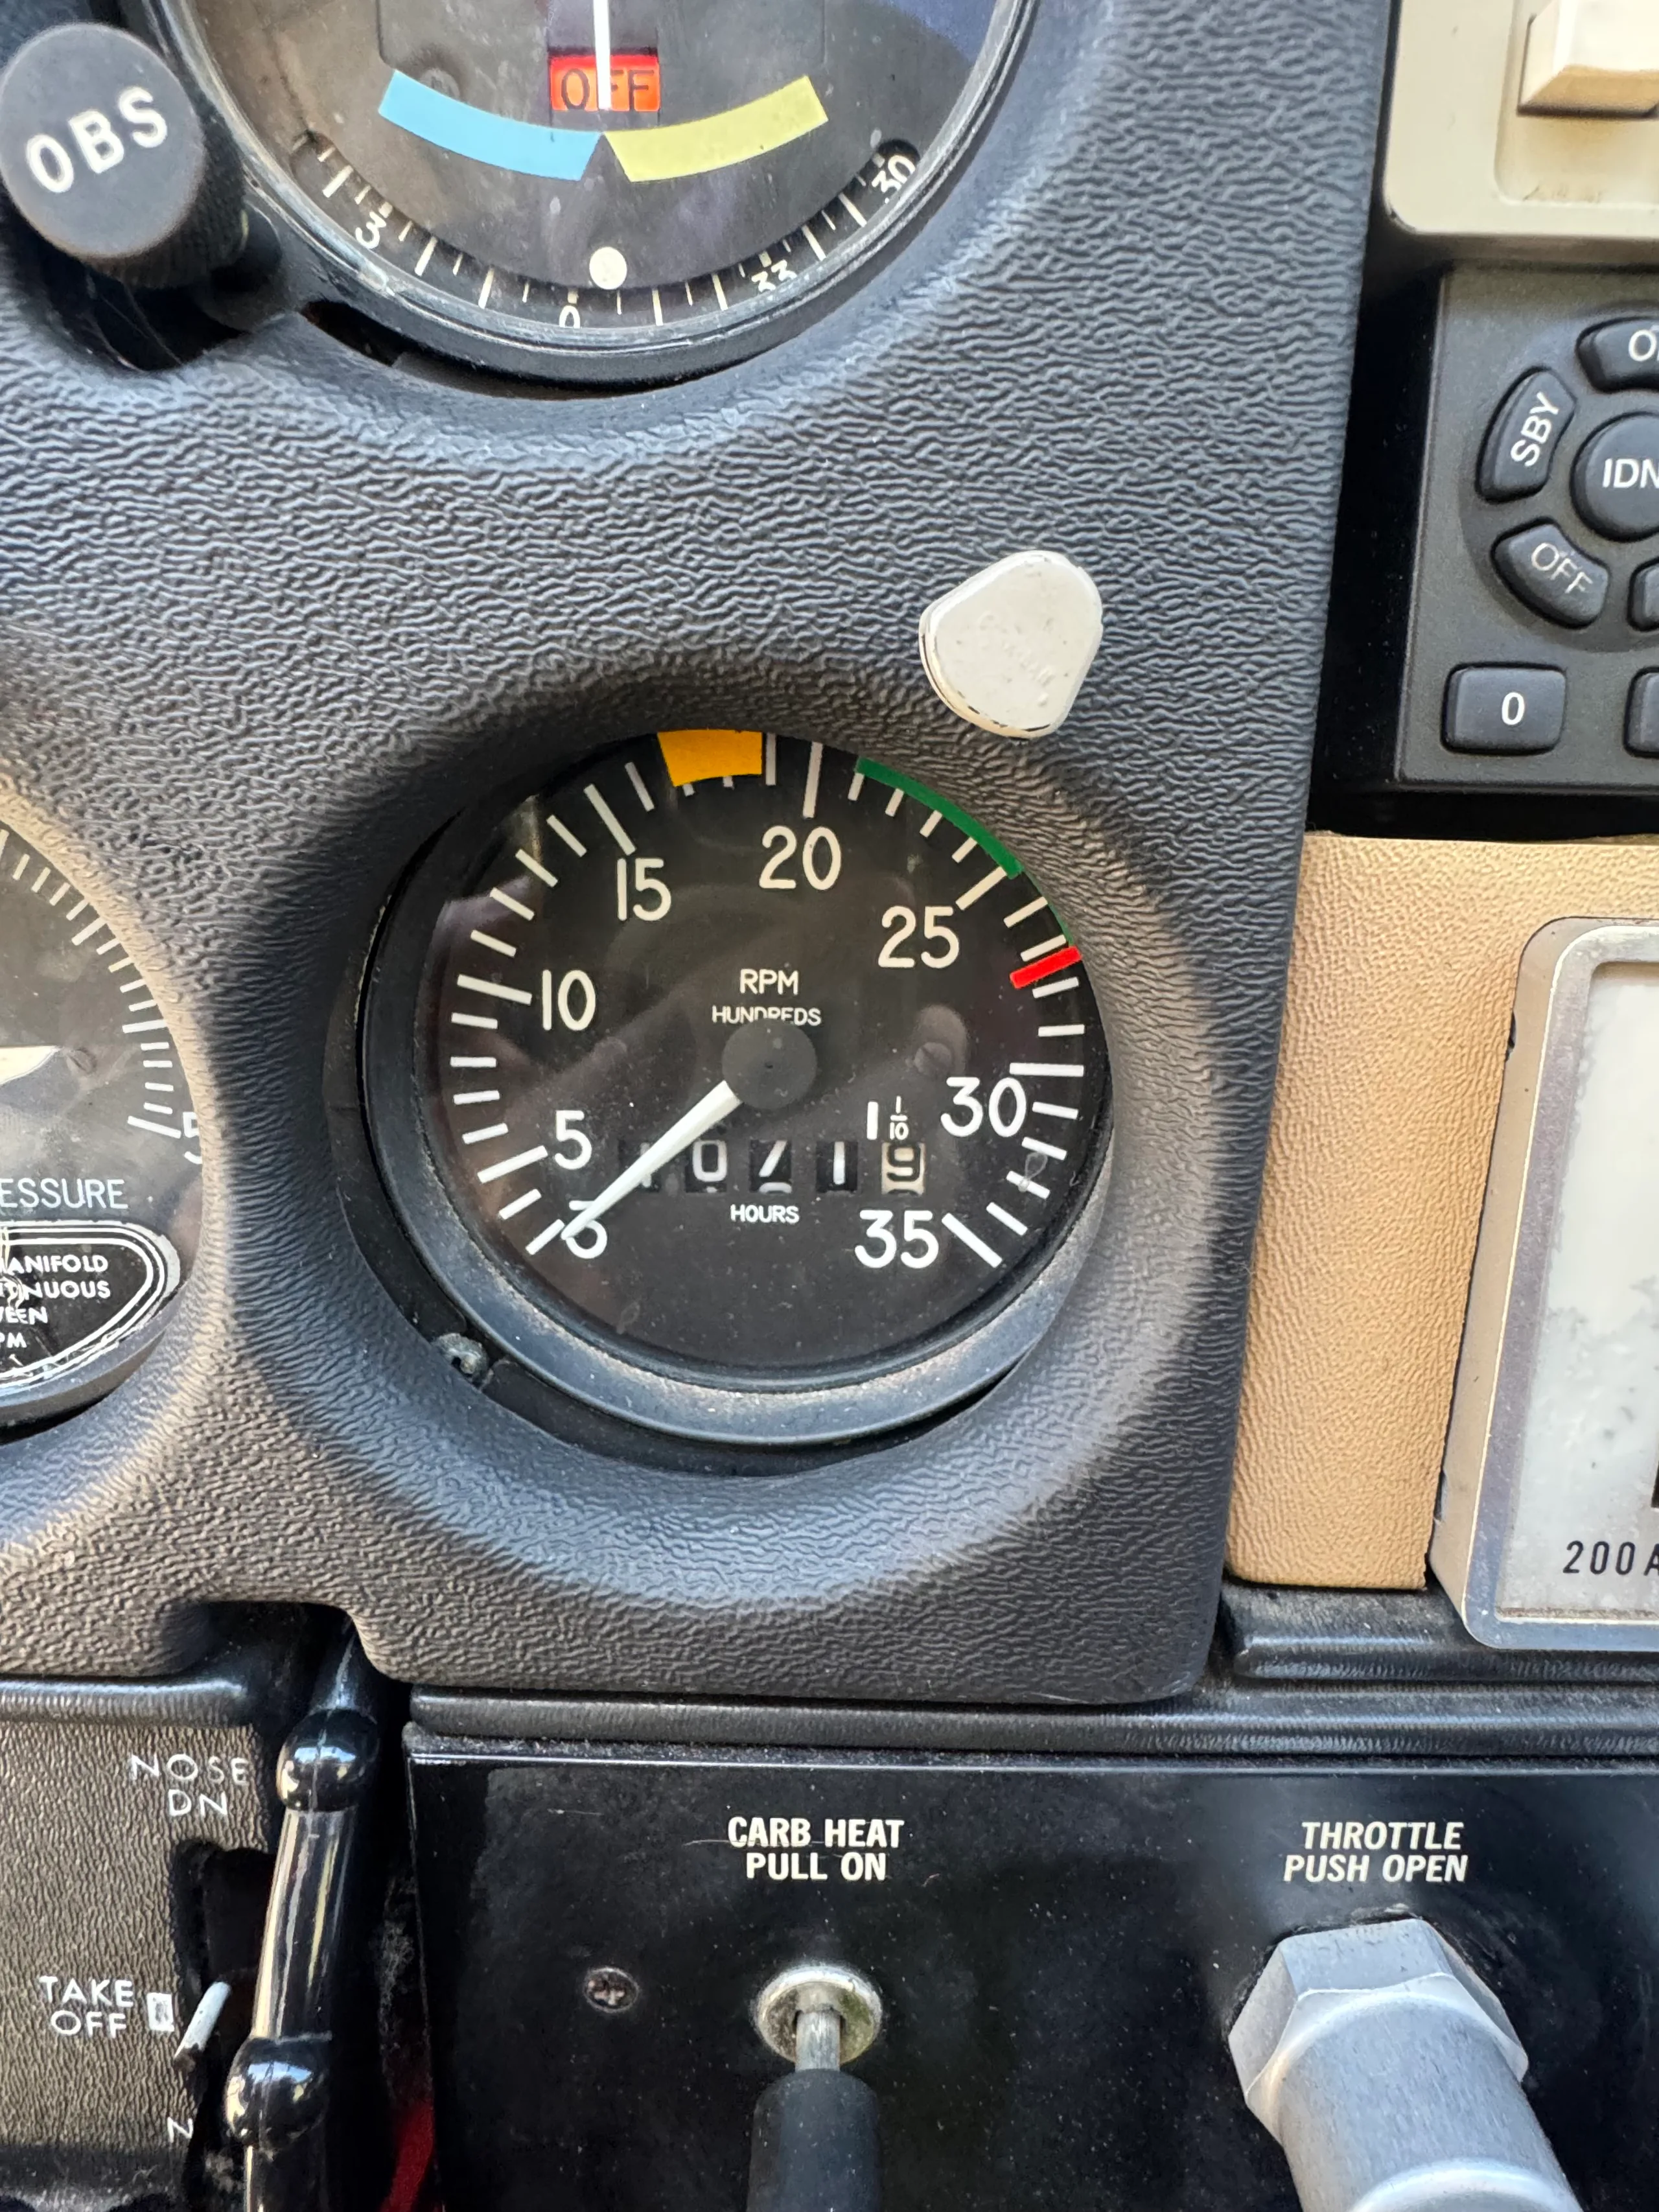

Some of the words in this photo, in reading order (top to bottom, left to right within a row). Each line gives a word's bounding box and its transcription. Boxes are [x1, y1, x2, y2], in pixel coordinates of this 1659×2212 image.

[26, 86, 167, 192] OBS
[1511, 392, 1559, 467] SBY
[1531, 542, 1593, 596] OFF
[1501, 692, 1525, 725] 0
[759, 826, 842, 891] 20
[616, 858, 671, 921] 15
[878, 905, 960, 968] 25
[739, 968, 798, 995] RPM
[542, 970, 596, 1031] 10
[940, 1077, 1027, 1137] 30
[555, 1110, 592, 1170] 5
[730, 1205, 800, 1224] HOURS
[854, 1209, 939, 1269] 35
[130, 1754, 250, 1786] NOSE
[168, 1789, 228, 1815] DN
[728, 1817, 811, 1848] CARB
[824, 1819, 905, 1848] HEAT
[1301, 1821, 1464, 1850] THROTTLE
[746, 1852, 828, 1880] PULL
[841, 1852, 887, 1881] ON
[1283, 1855, 1370, 1882] PUSH
[1382, 1855, 1468, 1882] OPEN
[39, 1976, 133, 2008] TAKE
[51, 2010, 128, 2038] OFF
